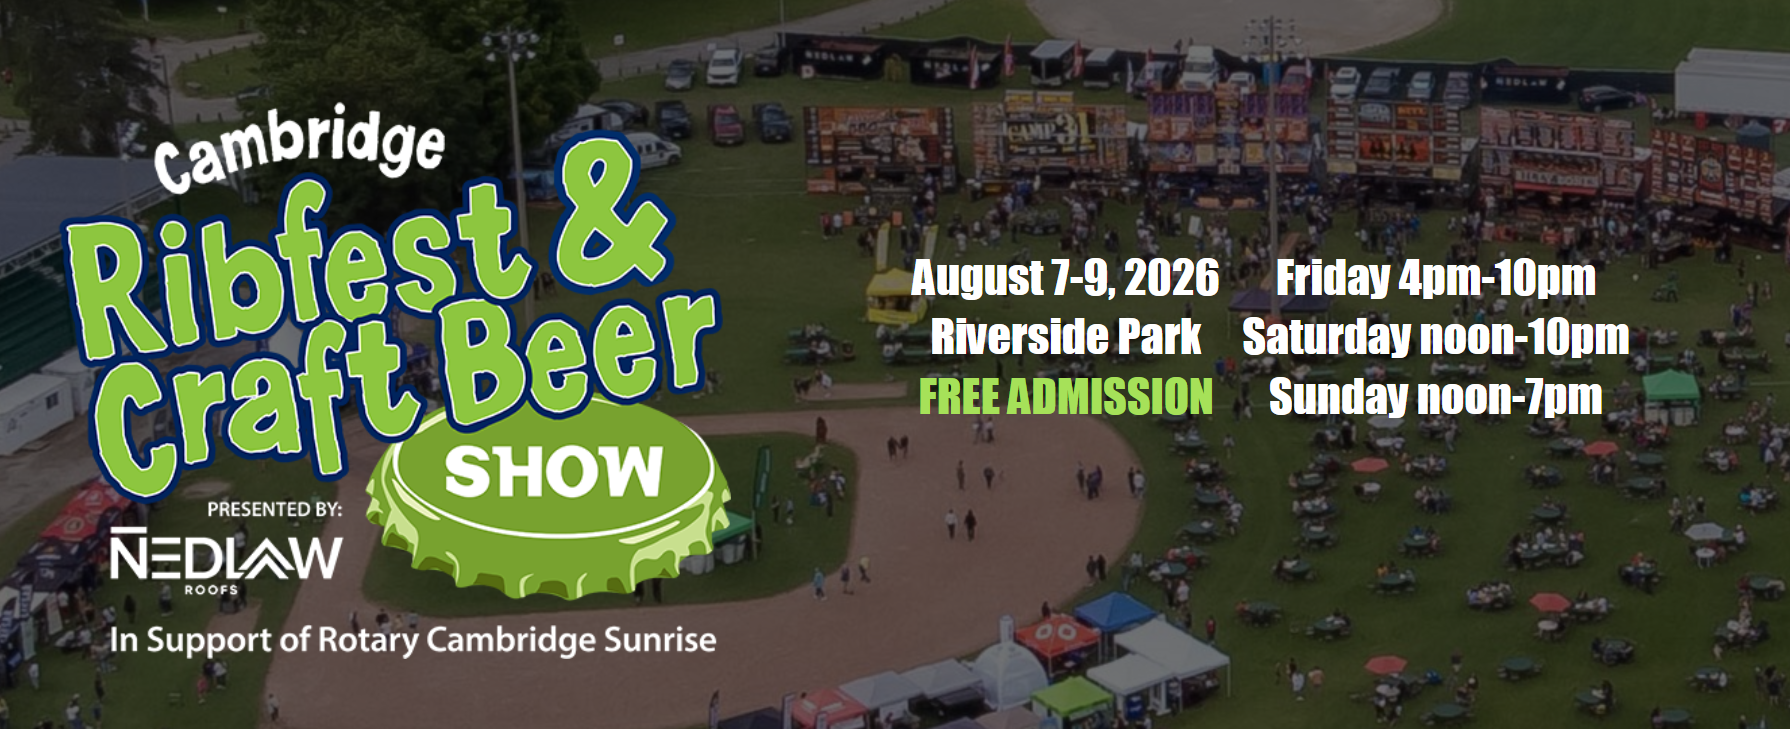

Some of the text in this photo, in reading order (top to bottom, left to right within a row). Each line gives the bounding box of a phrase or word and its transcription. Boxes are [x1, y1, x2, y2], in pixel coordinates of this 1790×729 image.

[1495, 76, 1548, 87] NEDLAW
[1008, 112, 1093, 144] CAMP 31
